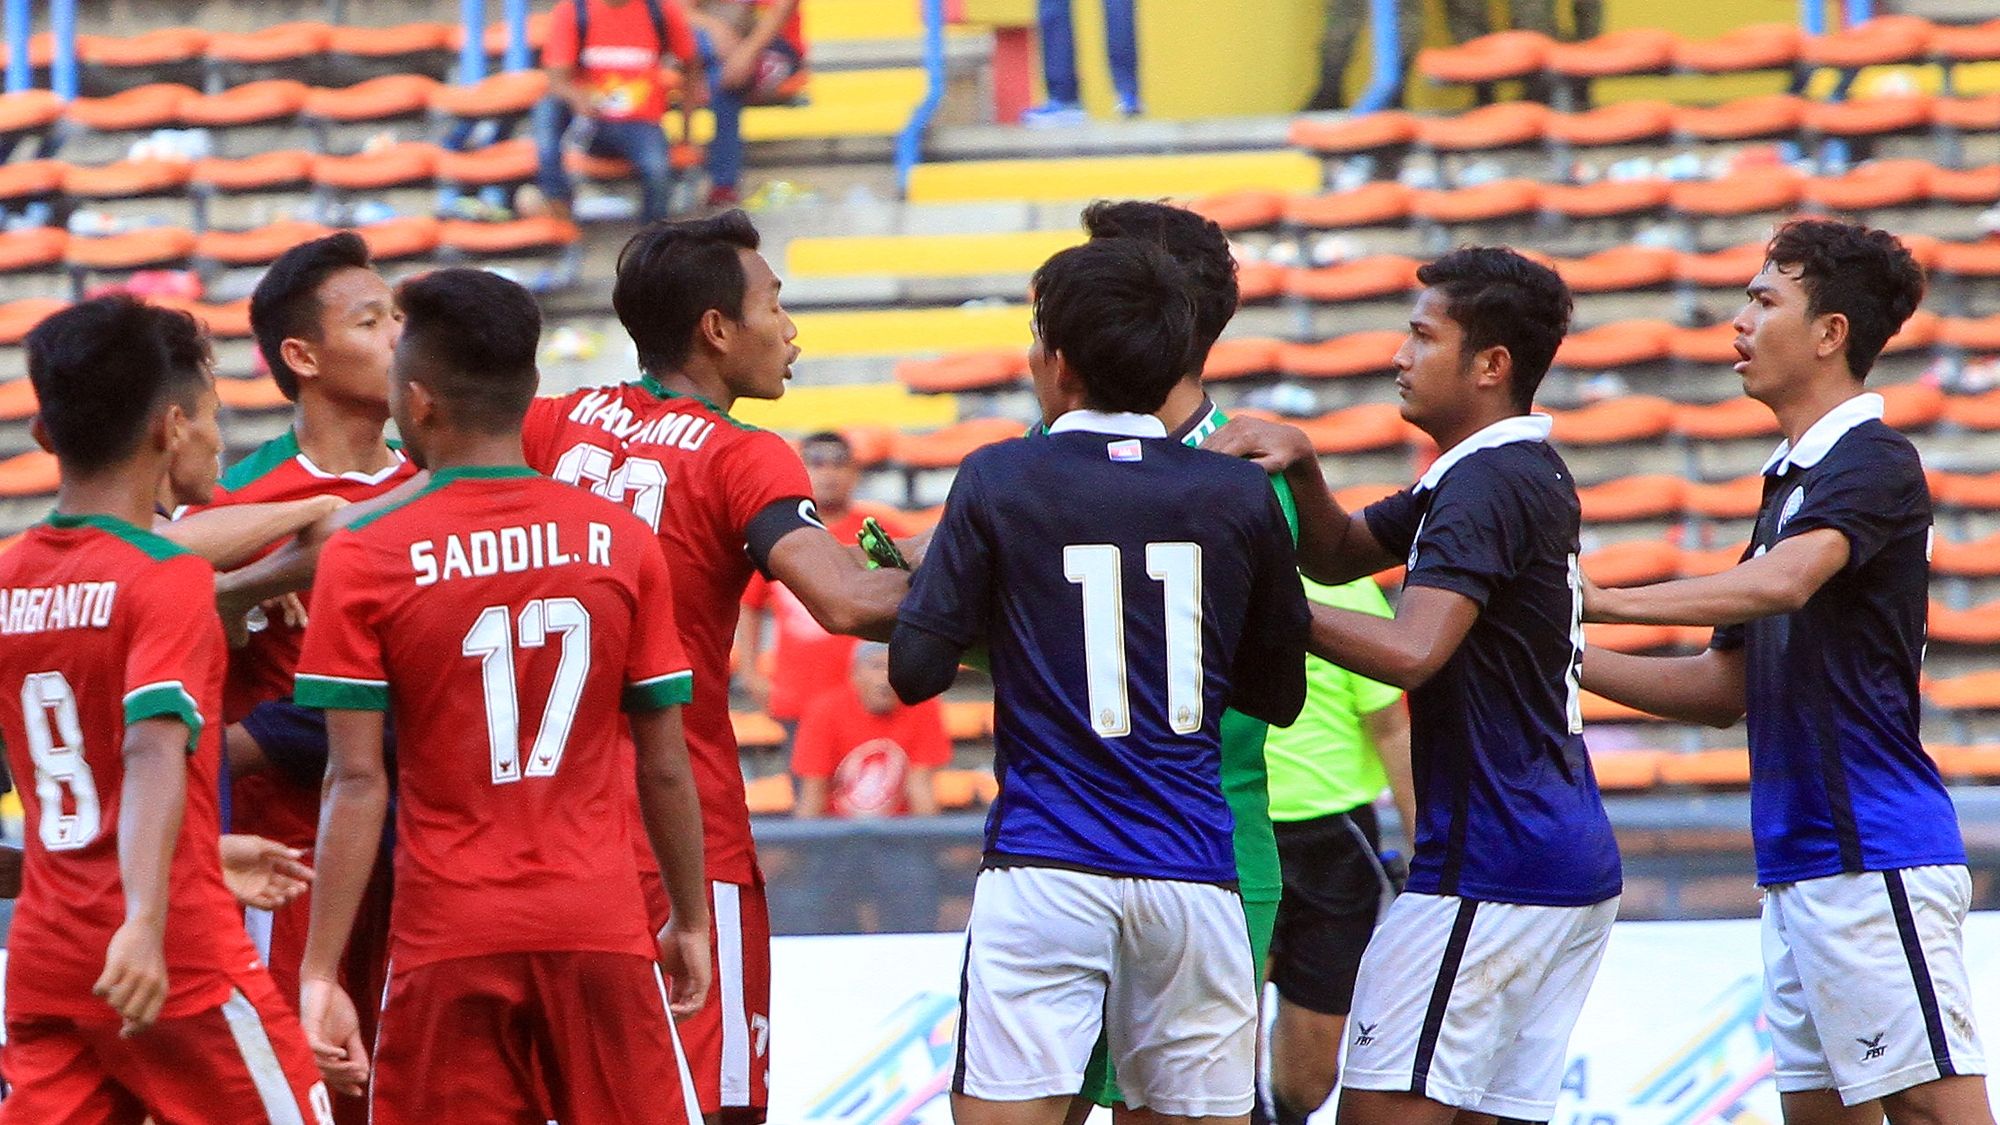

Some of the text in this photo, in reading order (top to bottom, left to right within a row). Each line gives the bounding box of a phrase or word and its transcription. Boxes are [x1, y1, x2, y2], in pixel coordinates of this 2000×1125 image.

[568, 390, 716, 451] HANAMU
[462, 597, 591, 785] 17
[1063, 542, 1202, 738] 11
[20, 671, 101, 851] 8
